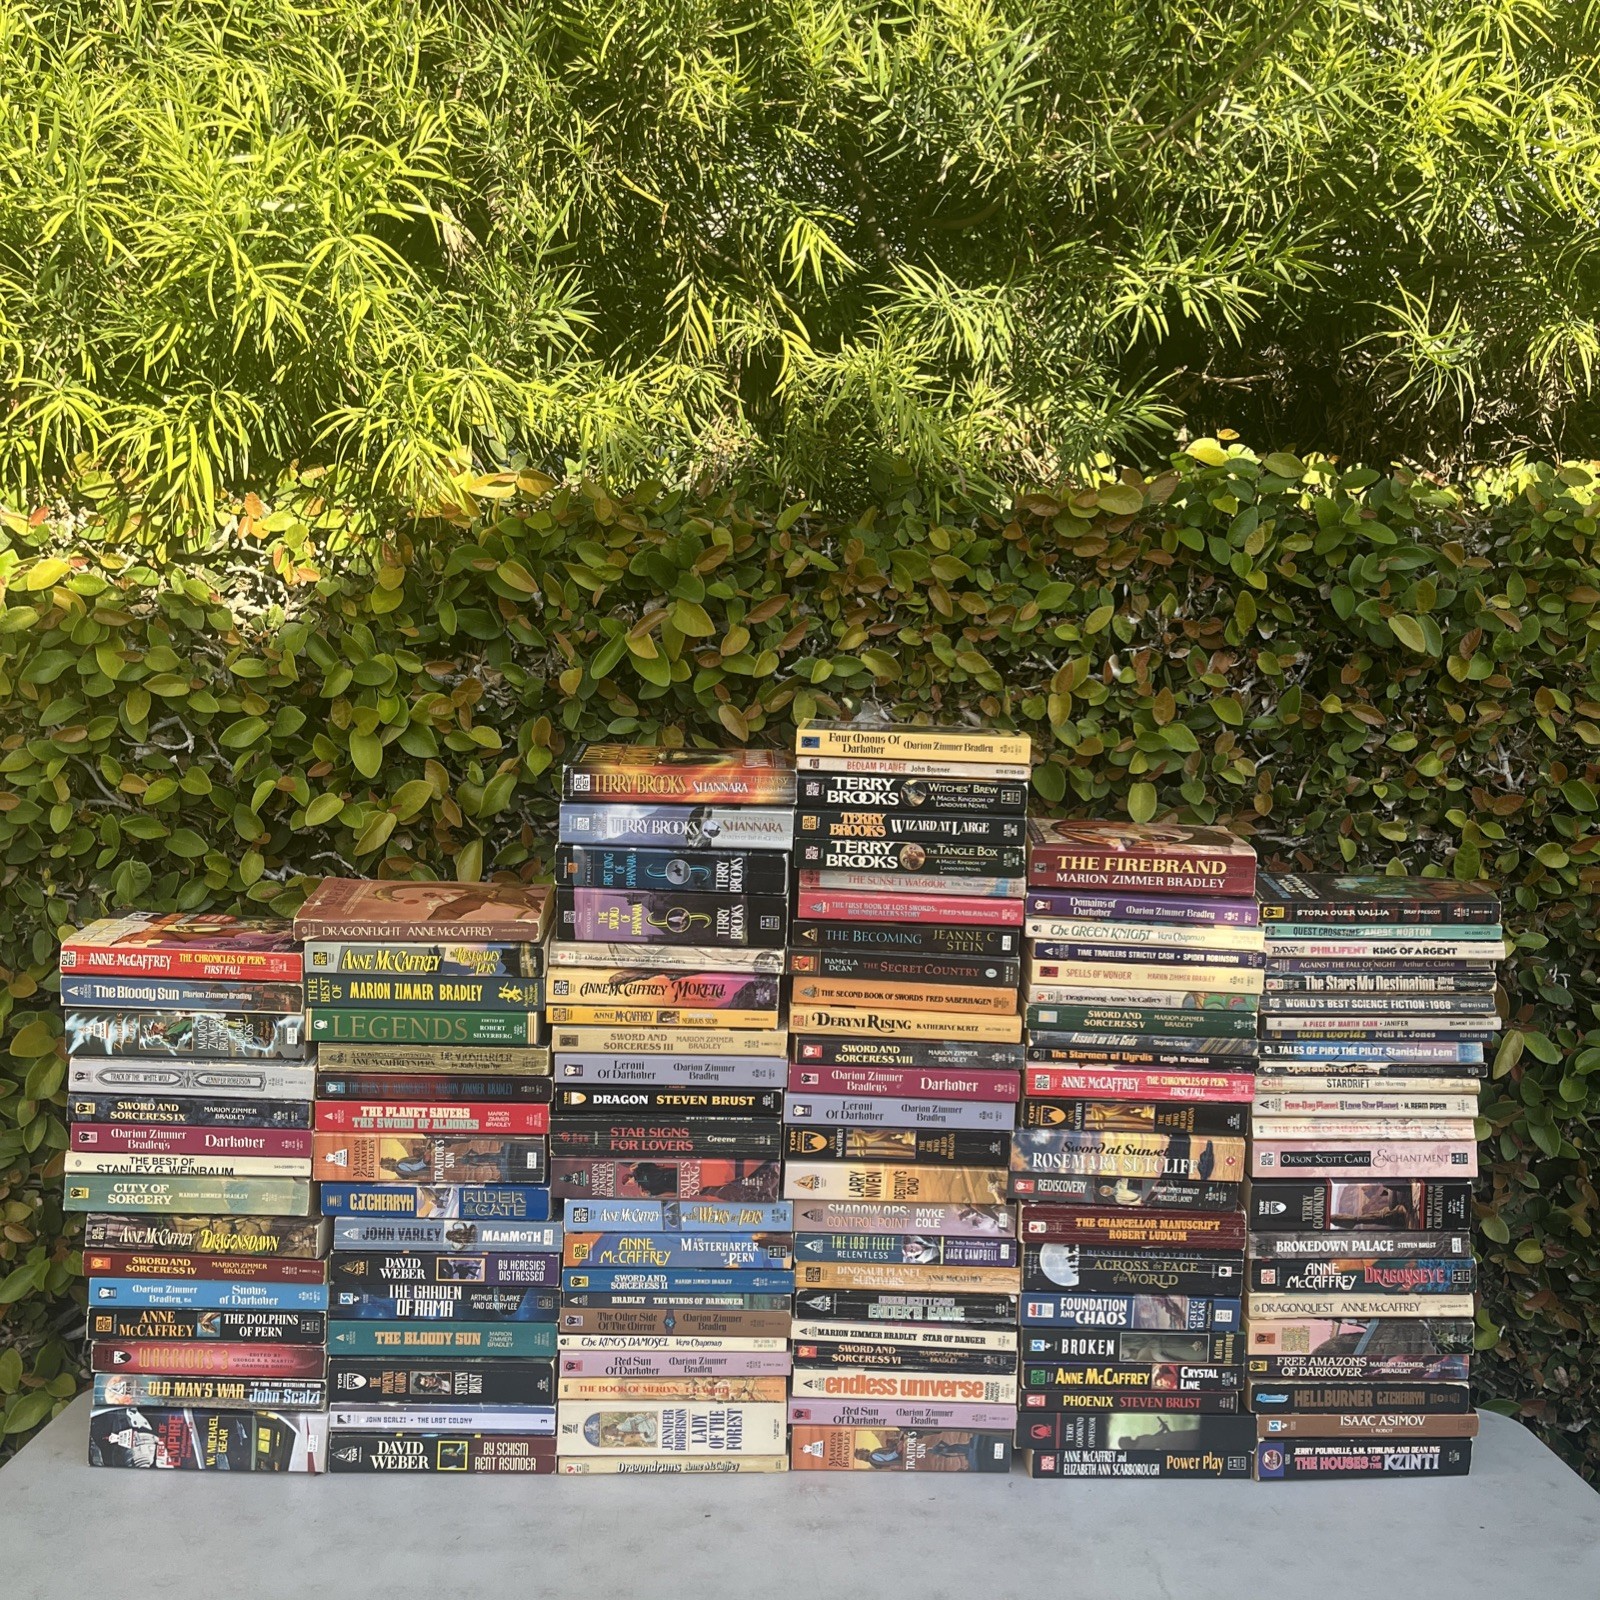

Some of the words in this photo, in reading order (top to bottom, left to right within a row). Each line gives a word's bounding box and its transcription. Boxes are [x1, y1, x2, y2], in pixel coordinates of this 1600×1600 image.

[592, 774, 635, 792] TERRY
[637, 775, 687, 794] BROOKS
[693, 780, 748, 793] SHANNARA
[831, 777, 895, 791] TERRY
[928, 783, 970, 793] WITCHES'
[973, 785, 999, 794] BREW
[827, 791, 899, 805] BROOKS
[1057, 856, 1100, 870] THE
[1104, 857, 1227, 875] FIREBRAND
[1056, 873, 1108, 884] MARION
[1112, 875, 1163, 886] ZIMMER
[1167, 877, 1225, 889] BRADLEY
[322, 926, 401, 936] DRAGONFLIGHT
[407, 927, 436, 936] ANNE
[437, 927, 494, 936] McCAFFREY
[826, 930, 849, 940] THE
[853, 930, 922, 944] BECOMING
[932, 930, 981, 942] JEANNE
[986, 933, 998, 942] C.
[947, 941, 984, 951] STEIN
[89, 953, 115, 965] ANNE
[117, 954, 172, 970] McCAFFREY
[1129, 951, 1156, 959] STRICTLY
[1207, 955, 1238, 963] ROBINSON
[94, 985, 116, 998] The
[117, 986, 155, 1001] Bloody
[158, 987, 179, 1000] Sun
[350, 982, 390, 1000] MARION
[395, 983, 434, 1000] ZIMMER
[440, 984, 483, 1001] BRADLEY
[821, 989, 834, 997] THE
[836, 990, 863, 999] SECOND
[864, 991, 884, 999] BOOK
[895, 992, 923, 1001] SWORDS
[945, 995, 991, 1005] SABERHAGEN
[1285, 1000, 1326, 1008] WORLD'S
[1328, 1000, 1349, 1009] BEST
[1352, 1000, 1388, 1009] SCIENCE
[332, 1016, 468, 1040] LEGENDS
[1278, 1045, 1304, 1054] TALES
[1306, 1046, 1317, 1054] OF
[1319, 1046, 1339, 1055] PIRX
[1340, 1047, 1356, 1055] THE
[1386, 1048, 1431, 1056] Stanislaw
[1433, 1048, 1452, 1056] Lem
[117, 1102, 155, 1110] SWORD
[157, 1103, 179, 1111] AND
[593, 1095, 648, 1105] DRAGON
[656, 1096, 708, 1105] STEVEN
[712, 1096, 755, 1106] BRUST
[110, 1111, 173, 1121] SORCERESS
[174, 1113, 186, 1121] IX
[361, 1106, 383, 1116] THE
[386, 1107, 427, 1117] PLANET
[430, 1108, 470, 1118] SAVERS
[610, 1127, 645, 1137] STAR
[649, 1128, 689, 1138] SIGNS
[205, 1134, 265, 1148] Darkover
[707, 1135, 737, 1143] Greene
[610, 1140, 638, 1150] FOR
[642, 1140, 693, 1151] LOVERS
[1282, 1154, 1312, 1163] ORSON
[1316, 1154, 1342, 1163] SCOTT
[1344, 1154, 1370, 1163] CARD
[114, 1183, 150, 1193] CITY
[152, 1184, 169, 1193] OF
[108, 1193, 173, 1205] SORCERY
[916, 1209, 945, 1218] MYKE
[916, 1219, 941, 1228] COLE
[1075, 1218, 1095, 1228] THE
[1098, 1218, 1157, 1230] CHANCELLOR
[1160, 1221, 1220, 1231] MANUSCRIPT
[1109, 1230, 1146, 1240] ROBERT
[1148, 1231, 1187, 1241] LUDLUM
[618, 1238, 656, 1250] ANNE
[681, 1238, 759, 1251] MASTERHARPER
[1276, 1240, 1348, 1253] BROKEDOWN
[1352, 1240, 1393, 1251] PALACE
[599, 1251, 671, 1266] McCAFFREY
[837, 1251, 888, 1259] RELENTLESS
[385, 1258, 421, 1268] DAVID
[379, 1268, 426, 1279] WEBER
[612, 1296, 646, 1304] BRADLEY
[1060, 1298, 1127, 1311] FOUNDATION
[1262, 1303, 1333, 1314] DRAGONQUEST
[1341, 1303, 1369, 1312] ANNE
[1369, 1303, 1420, 1312] McCAFFREY
[140, 1311, 175, 1323] ANNE
[224, 1314, 245, 1324] THE
[246, 1314, 298, 1325] DOLPHINS
[1060, 1310, 1074, 1318] AND
[1075, 1312, 1127, 1325] CHAOS
[119, 1325, 194, 1337] McCAFFREY
[239, 1326, 256, 1336] OF
[258, 1326, 283, 1337] PERN
[375, 1332, 401, 1344] THE
[404, 1332, 453, 1345] BLOODY
[456, 1333, 481, 1345] SUN
[1062, 1339, 1115, 1355] BROKEN
[1276, 1357, 1307, 1366] FREE
[1308, 1357, 1367, 1366] AMAZONS
[1055, 1368, 1084, 1384] ANNE
[1085, 1368, 1150, 1385] McCAFFREY
[1180, 1367, 1218, 1378] CRYSTAL
[1281, 1368, 1297, 1376] OF
[1300, 1367, 1363, 1377] DARKOVER
[826, 1375, 897, 1394] endless
[901, 1377, 984, 1398] universe
[1180, 1379, 1200, 1389] LINE
[148, 1382, 170, 1396] OLD
[174, 1383, 213, 1397] MAN'S
[217, 1384, 244, 1399] WAR
[249, 1388, 281, 1403] John
[283, 1390, 320, 1404] Scalzi
[1063, 1396, 1113, 1407] PHOENIX
[1120, 1397, 1162, 1407] STEVEN
[1166, 1397, 1201, 1408] BRUST
[709, 1410, 724, 1428] THE
[1340, 1416, 1376, 1426] ISAAC
[1379, 1416, 1425, 1426] ASIMOV
[662, 1409, 674, 1449] JENNIFER
[675, 1409, 687, 1450] ROBERSON
[692, 1414, 708, 1444] LADY
[726, 1408, 742, 1450] FOREST
[709, 1430, 724, 1449] OF
[378, 1441, 423, 1454] DAVID
[484, 1442, 495, 1454] BY
[496, 1442, 529, 1455] SCHISM
[370, 1455, 429, 1469] WEBER
[475, 1457, 496, 1469] RENT
[499, 1457, 536, 1470] ASUNDER
[1166, 1455, 1199, 1469] Power
[1203, 1452, 1224, 1475] Play
[1295, 1457, 1317, 1469] THE
[1320, 1457, 1368, 1469] HOUSES
[1383, 1454, 1439, 1470] KZINTI
